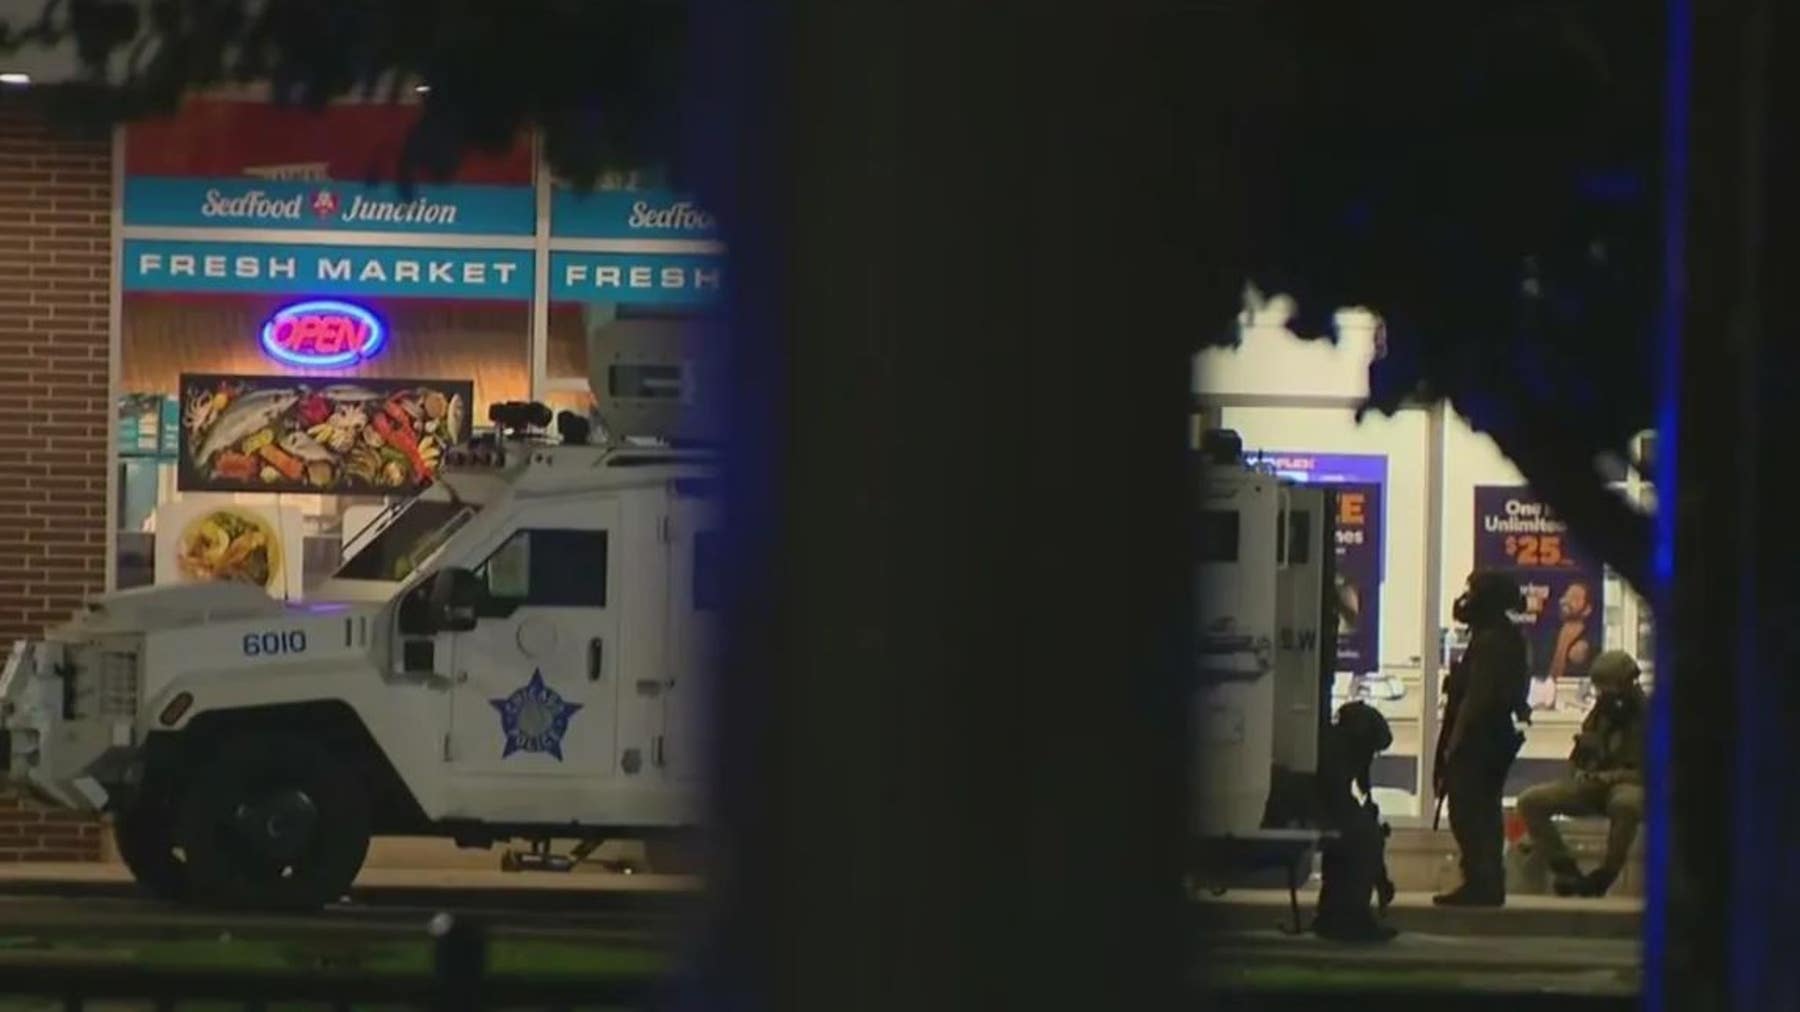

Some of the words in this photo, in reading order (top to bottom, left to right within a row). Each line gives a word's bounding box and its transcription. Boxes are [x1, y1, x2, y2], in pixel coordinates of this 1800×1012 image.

[341, 194, 457, 224] Junction
[139, 254, 296, 279] FRESH
[317, 258, 517, 284] MARKET
[565, 265, 720, 289] FRESH
[272, 315, 367, 353] OPEN
[1505, 535, 1562, 567] $25
[243, 630, 307, 657] 6010
